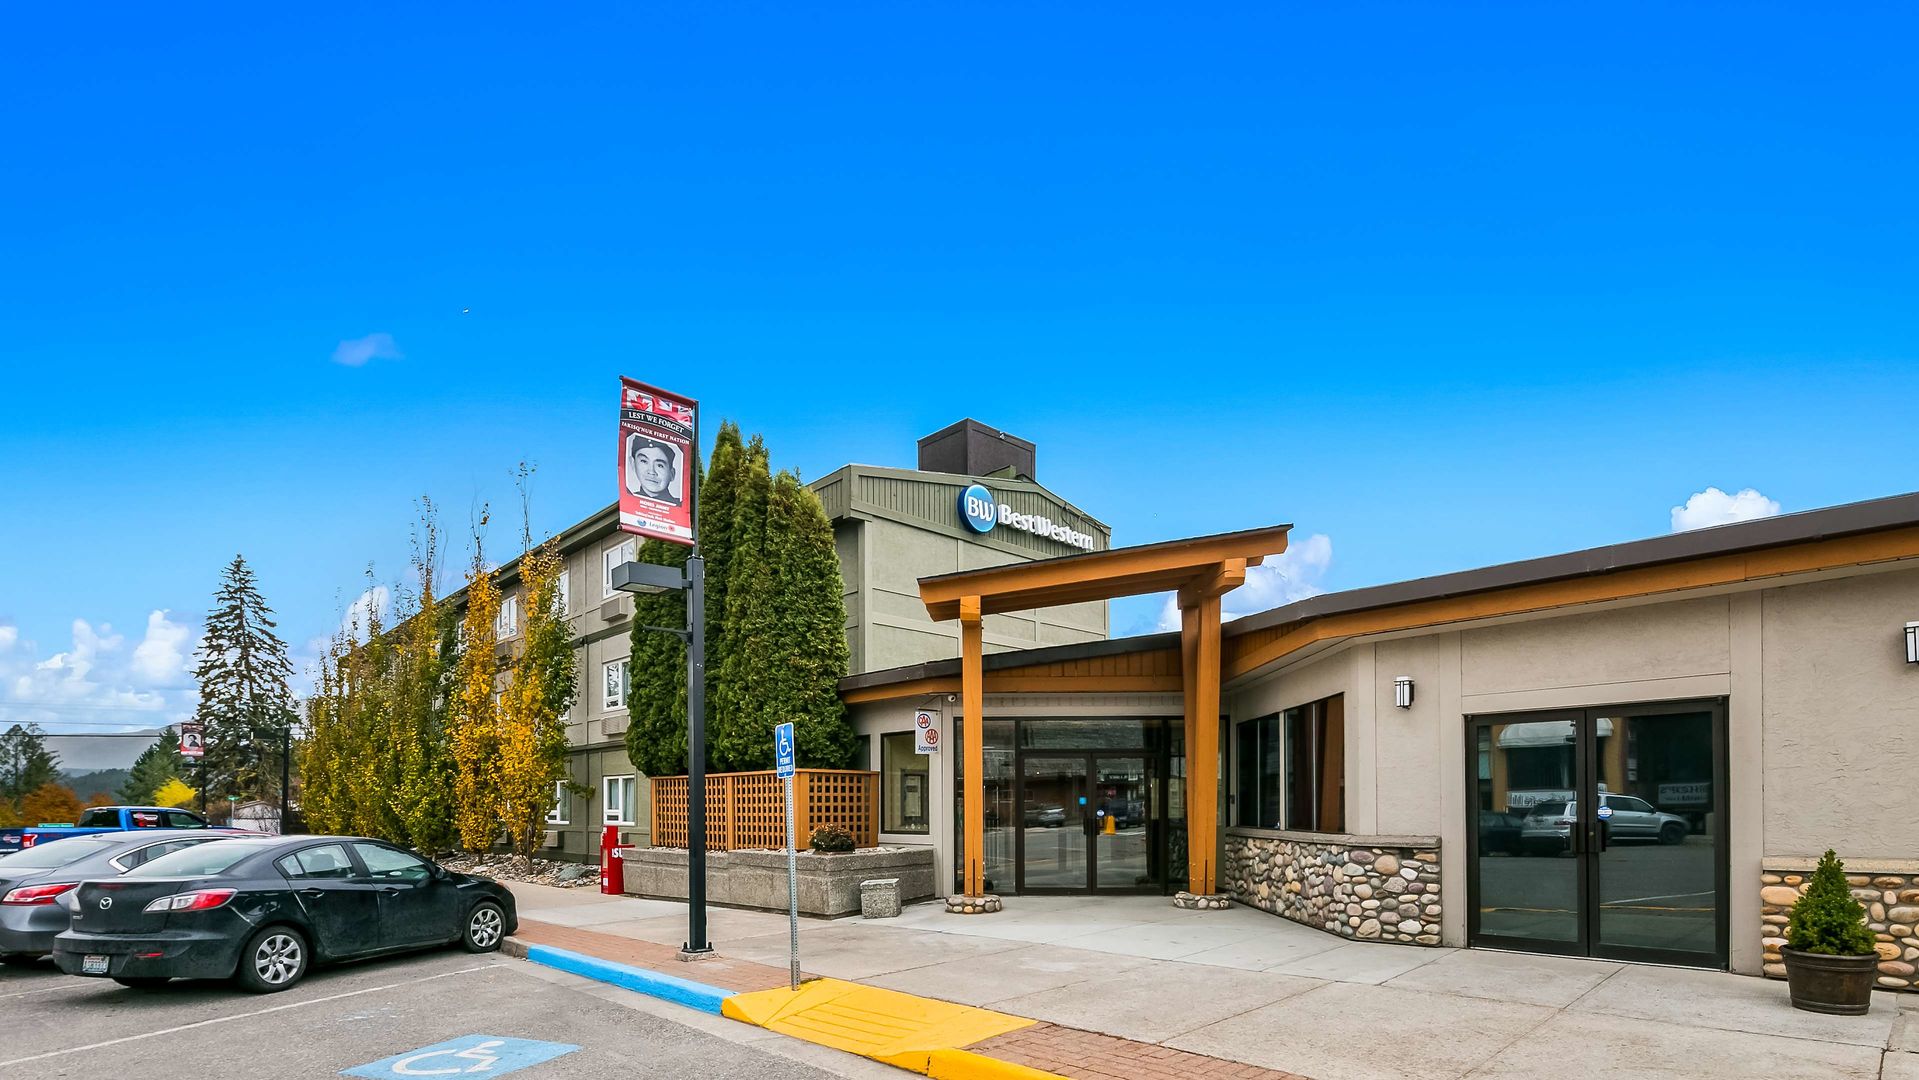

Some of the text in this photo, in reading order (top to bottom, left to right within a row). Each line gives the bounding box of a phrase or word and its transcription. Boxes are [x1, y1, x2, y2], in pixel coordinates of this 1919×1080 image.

[628, 411, 685, 434] LEST WE FORGET
[653, 430, 669, 440] FIRST
[669, 435, 690, 445] NATION
[967, 495, 995, 522] BW
[917, 744, 938, 752] Approved
